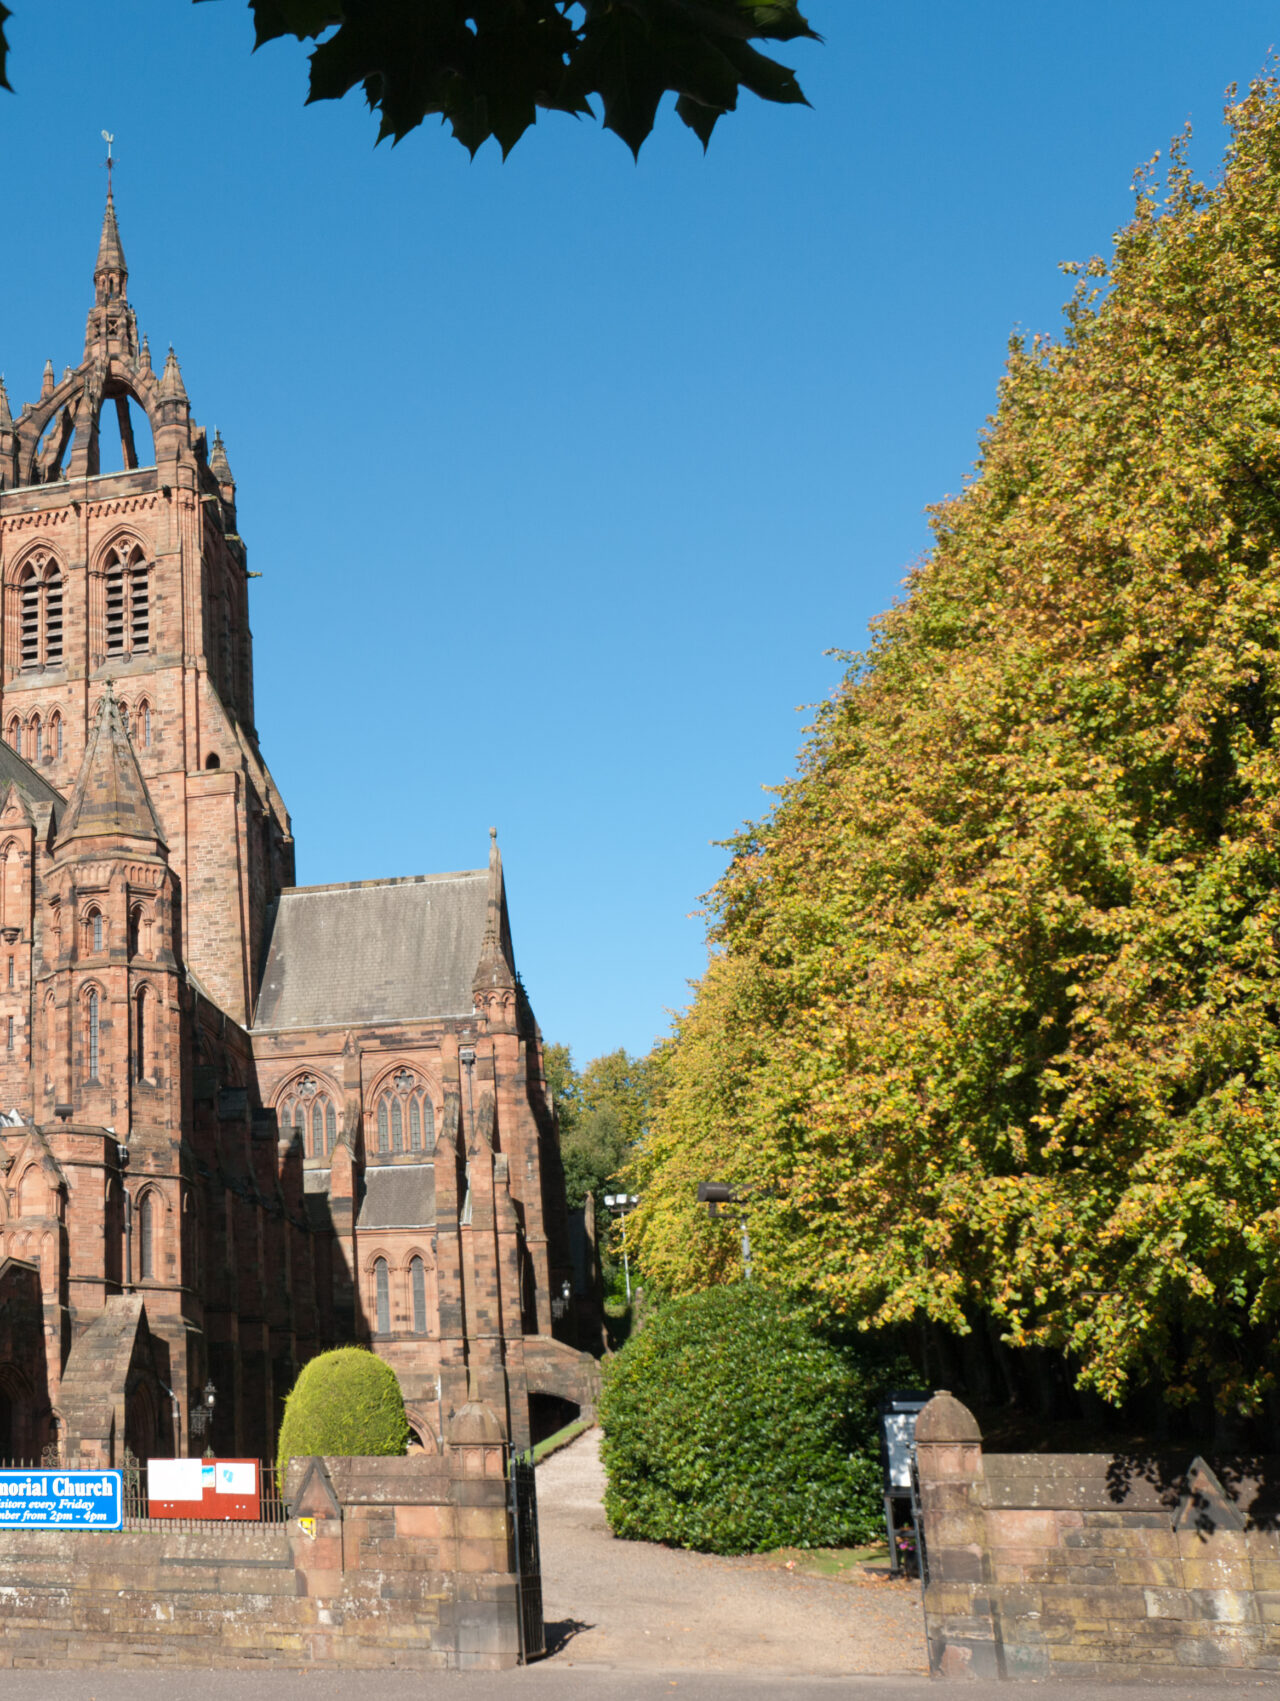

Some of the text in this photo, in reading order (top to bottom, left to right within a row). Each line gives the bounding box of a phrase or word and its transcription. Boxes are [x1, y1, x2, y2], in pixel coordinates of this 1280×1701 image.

[52, 1478, 113, 1496] Church
[28, 1502, 56, 1510] every
[58, 1499, 95, 1510] Friday
[21, 1511, 47, 1522] from
[49, 1511, 72, 1521] 2pm
[83, 1511, 107, 1521] 4pm
